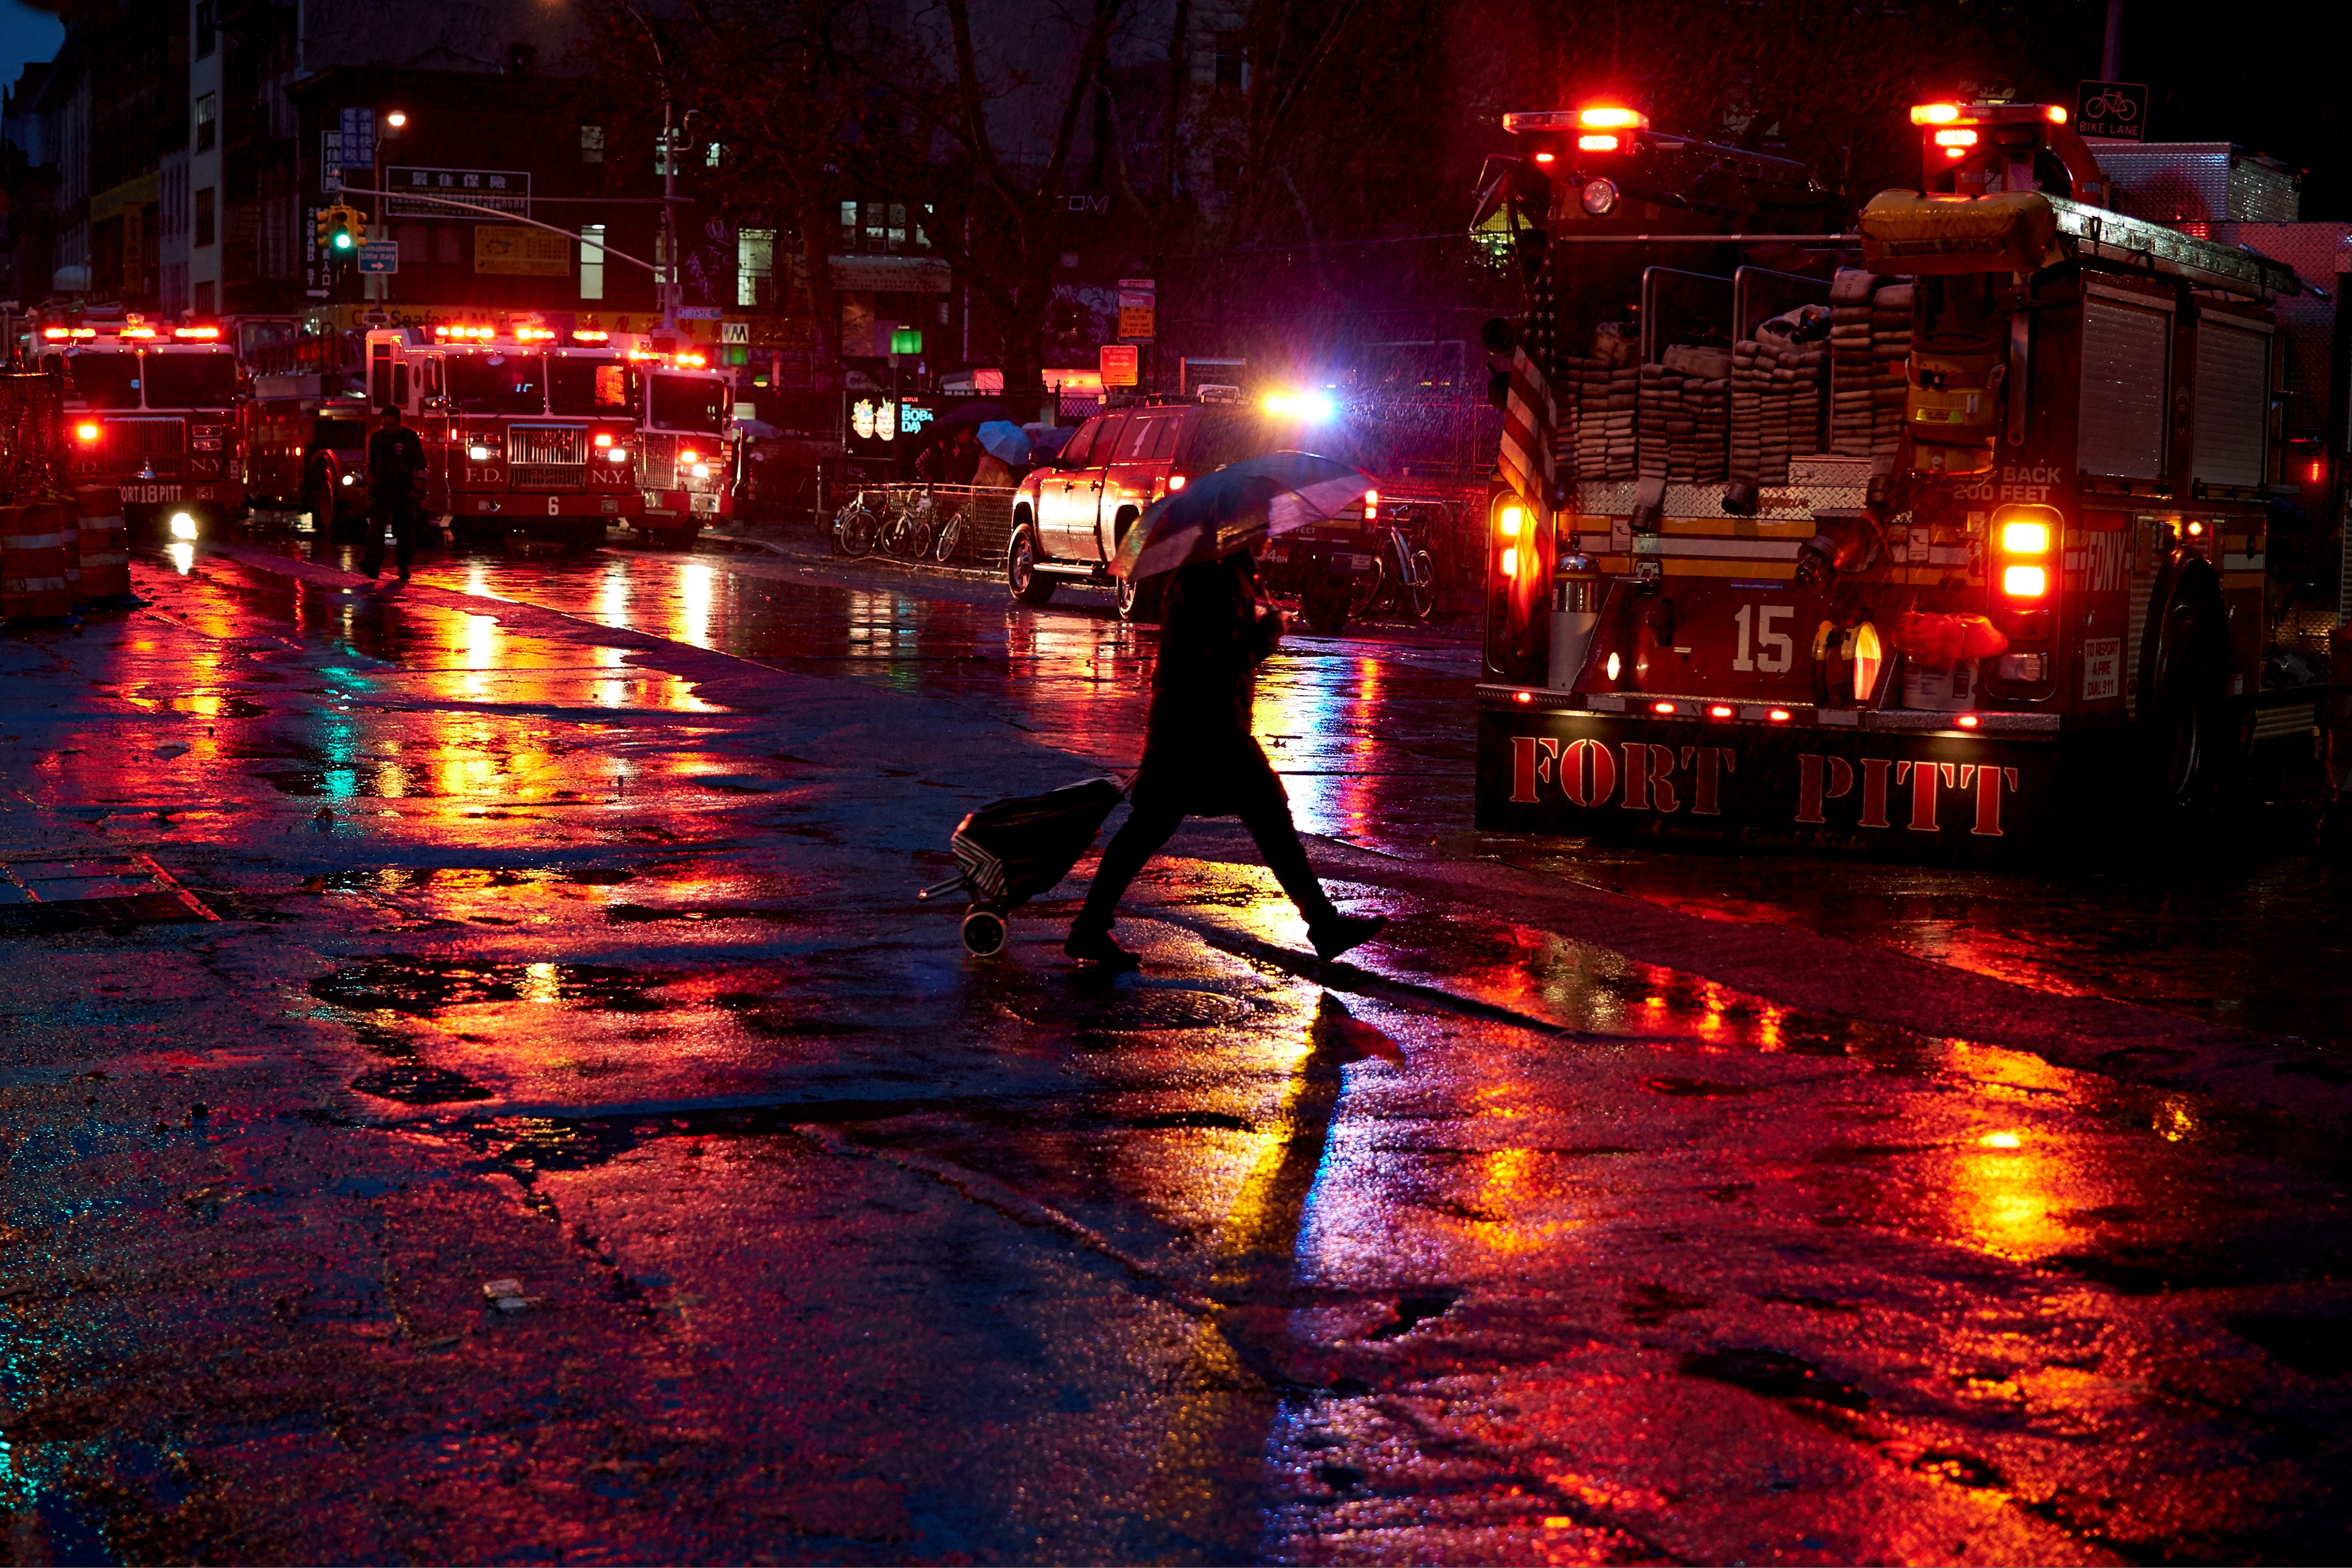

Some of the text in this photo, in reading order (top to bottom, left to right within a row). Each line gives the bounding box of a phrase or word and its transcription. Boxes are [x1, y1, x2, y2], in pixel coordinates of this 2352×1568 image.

[2079, 121, 2138, 136] BIKE LANE
[677, 307, 712, 318] CHRYSTIE
[902, 410, 927, 421] BOB
[466, 468, 628, 484] F.D. N.Y.
[2002, 466, 2062, 483] BACK
[123, 484, 183, 503] ORT 18 PITT
[1953, 483, 2051, 502] 200 FEET
[548, 496, 559, 516] 6
[2084, 530, 2127, 592] FDNY
[1732, 603, 1795, 674] 15
[2086, 641, 2119, 657] TO REPORT
[2092, 660, 2112, 676] A FIRE
[2087, 679, 2114, 696] DIAL 911
[1509, 736, 2019, 837] FORT PITT
